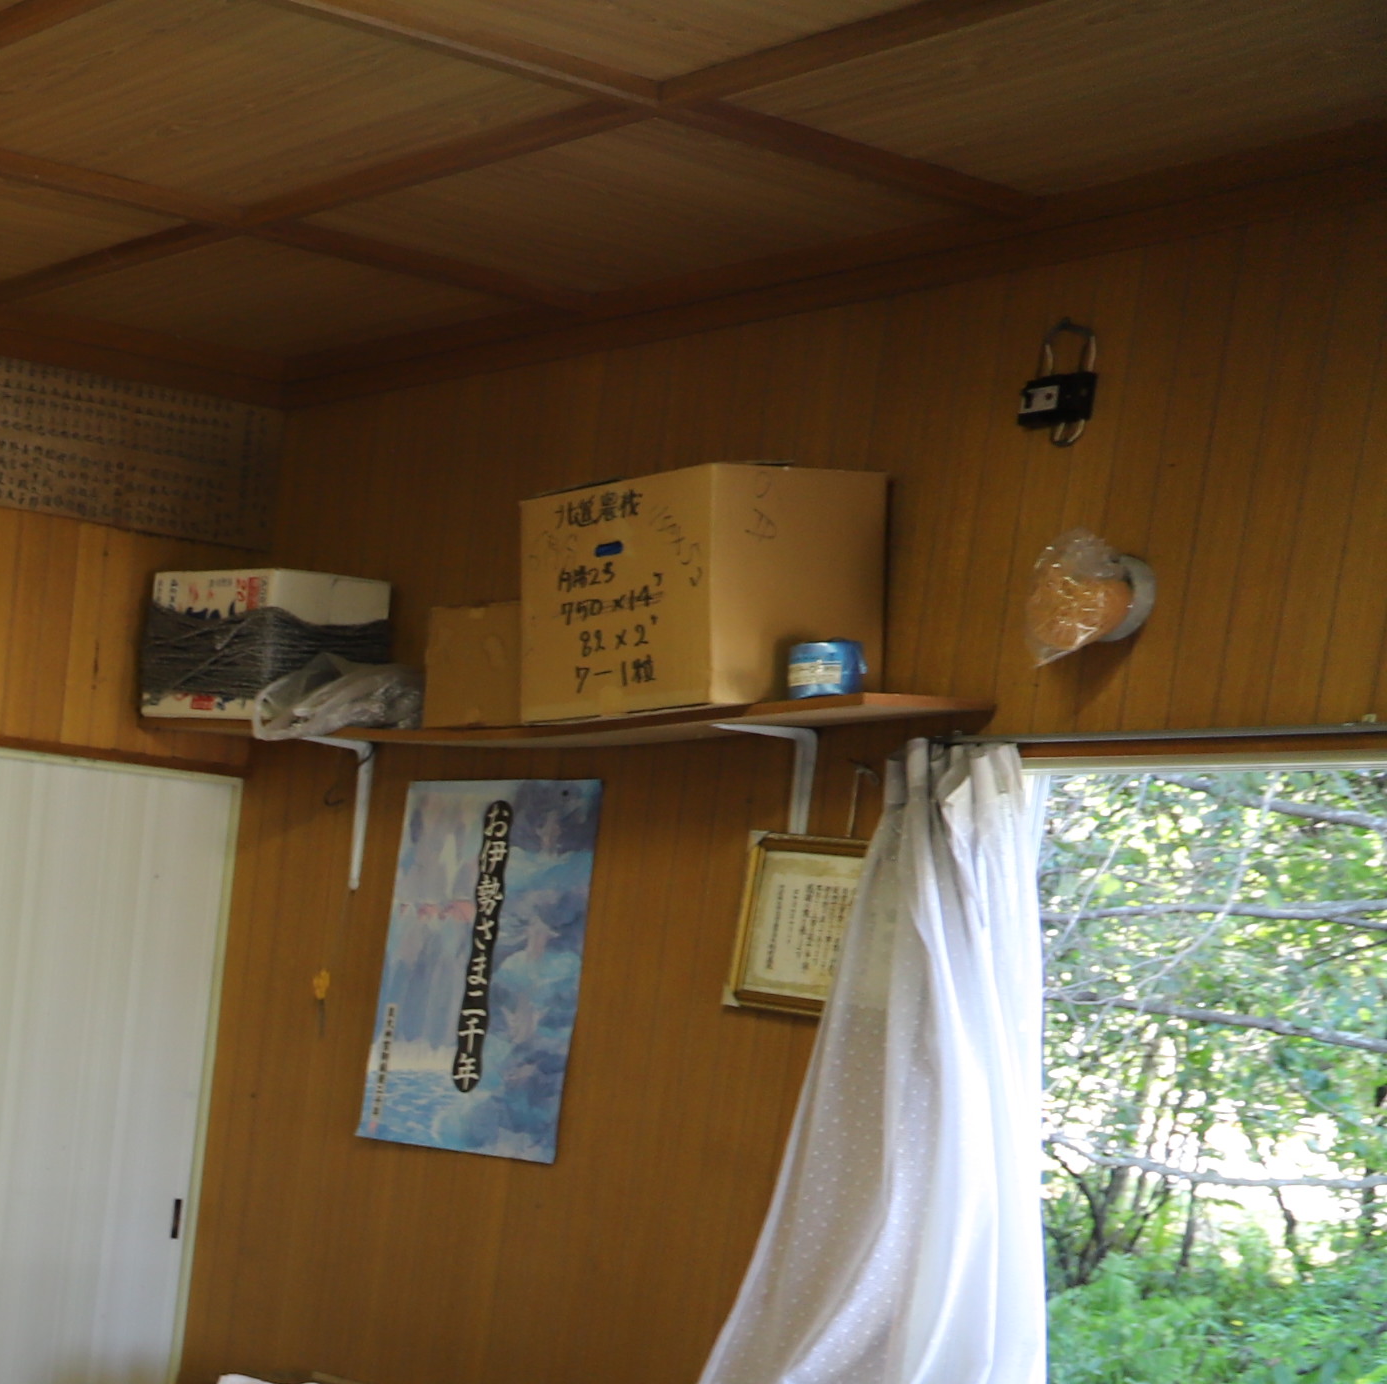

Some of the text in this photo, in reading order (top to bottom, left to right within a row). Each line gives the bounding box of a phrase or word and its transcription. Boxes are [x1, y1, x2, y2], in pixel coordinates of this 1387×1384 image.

[452, 802, 511, 1092] お伊勢さま二千年
